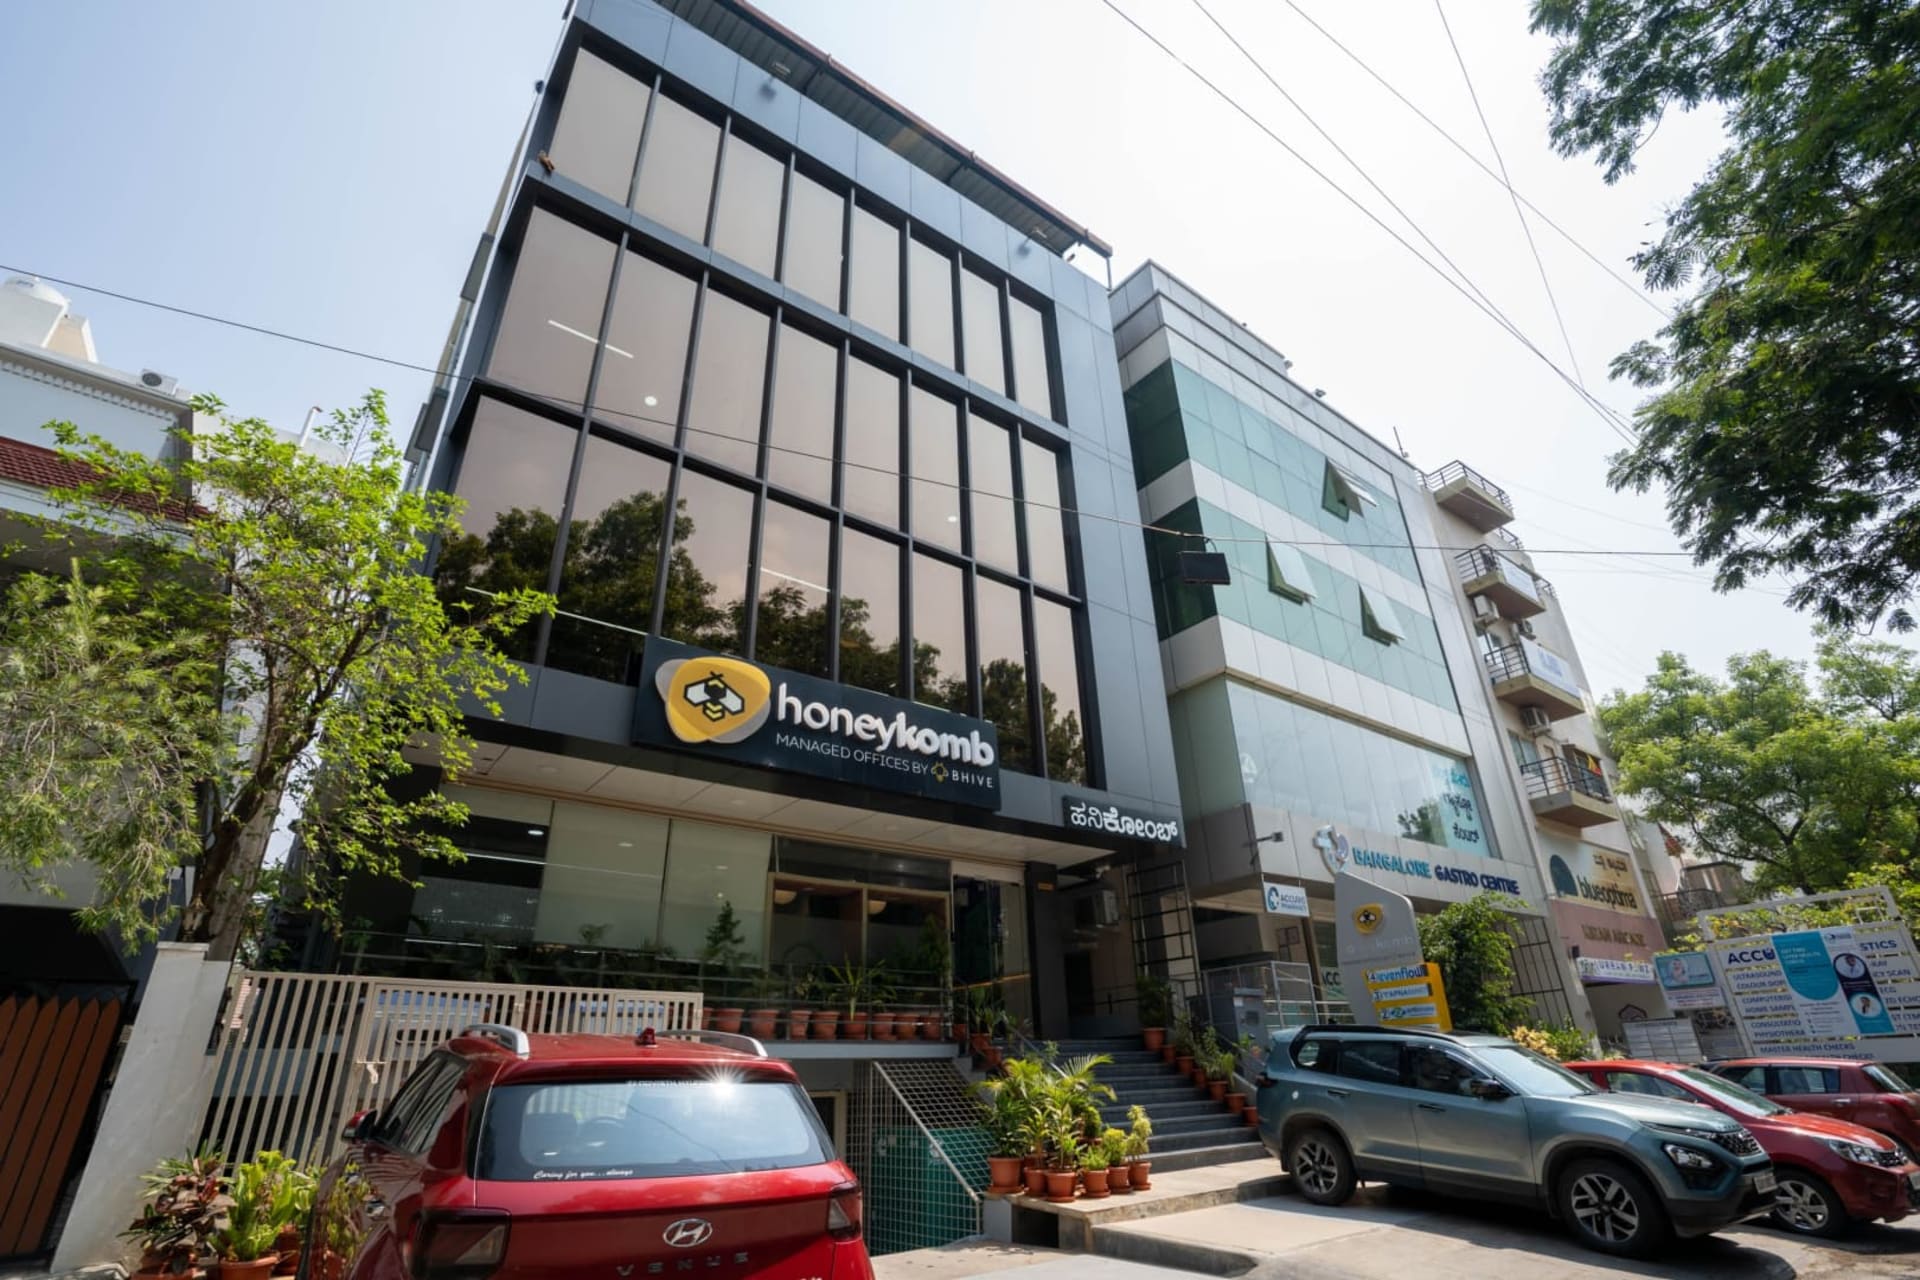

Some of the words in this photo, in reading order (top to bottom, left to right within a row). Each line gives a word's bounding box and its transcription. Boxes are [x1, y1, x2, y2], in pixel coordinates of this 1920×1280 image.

[777, 682, 995, 767] honeykomb
[776, 733, 851, 759] MANAGED
[853, 749, 910, 771] OFFICES
[912, 761, 929, 775] BY
[952, 770, 993, 789] BHIVE
[1069, 802, 1178, 842] ಹನಿಕೋಂಬ್
[1352, 847, 1432, 878] BANGALORE
[1434, 864, 1480, 887] GASTRO
[1480, 873, 1521, 896] CENTRE
[533, 1169, 563, 1180] Caring
[564, 1170, 578, 1180] for
[616, 1252, 749, 1277] VENUE
